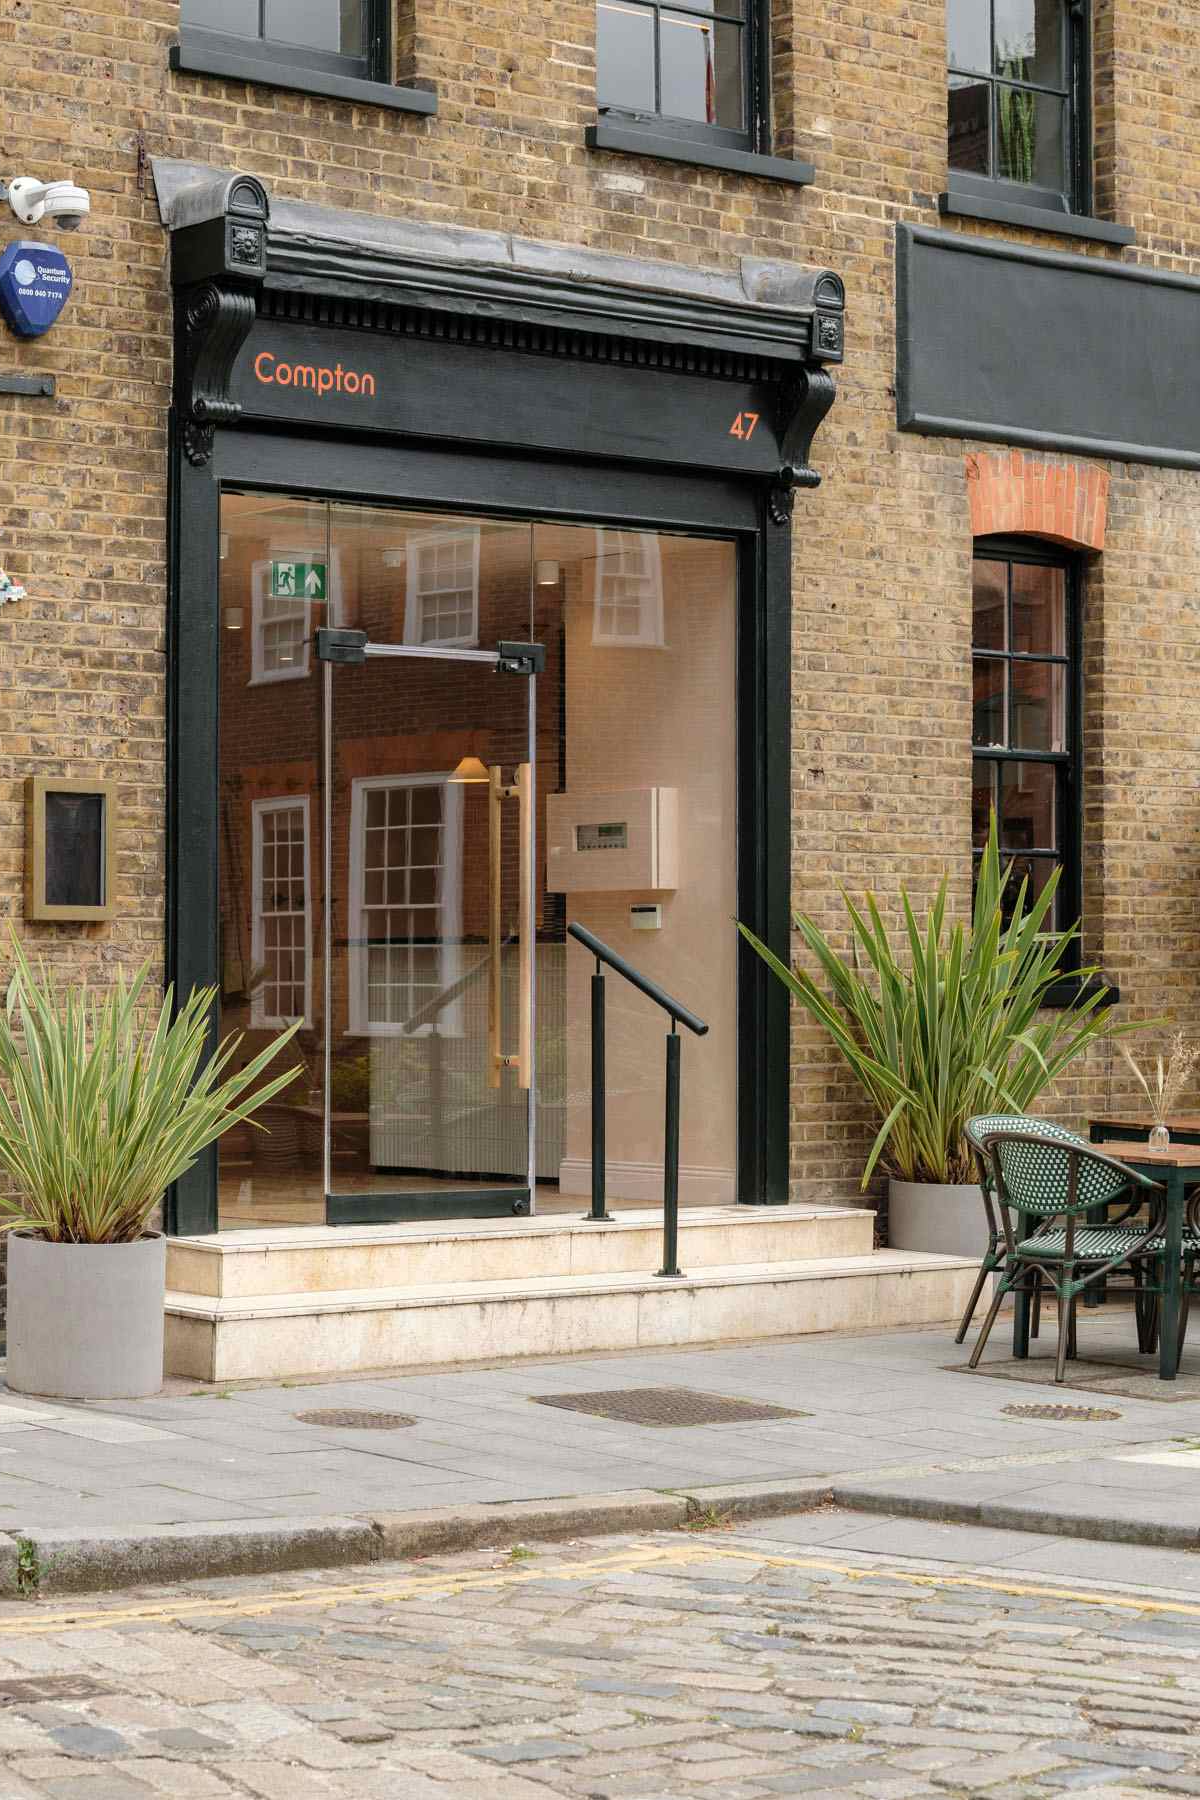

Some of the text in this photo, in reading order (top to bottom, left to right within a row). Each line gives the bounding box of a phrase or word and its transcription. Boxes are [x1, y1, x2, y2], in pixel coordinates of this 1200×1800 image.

[38, 266, 66, 275] Quantum
[42, 274, 71, 284] Security
[18, 288, 34, 296] 0800
[255, 351, 375, 396] Compton
[728, 411, 760, 441] 47
